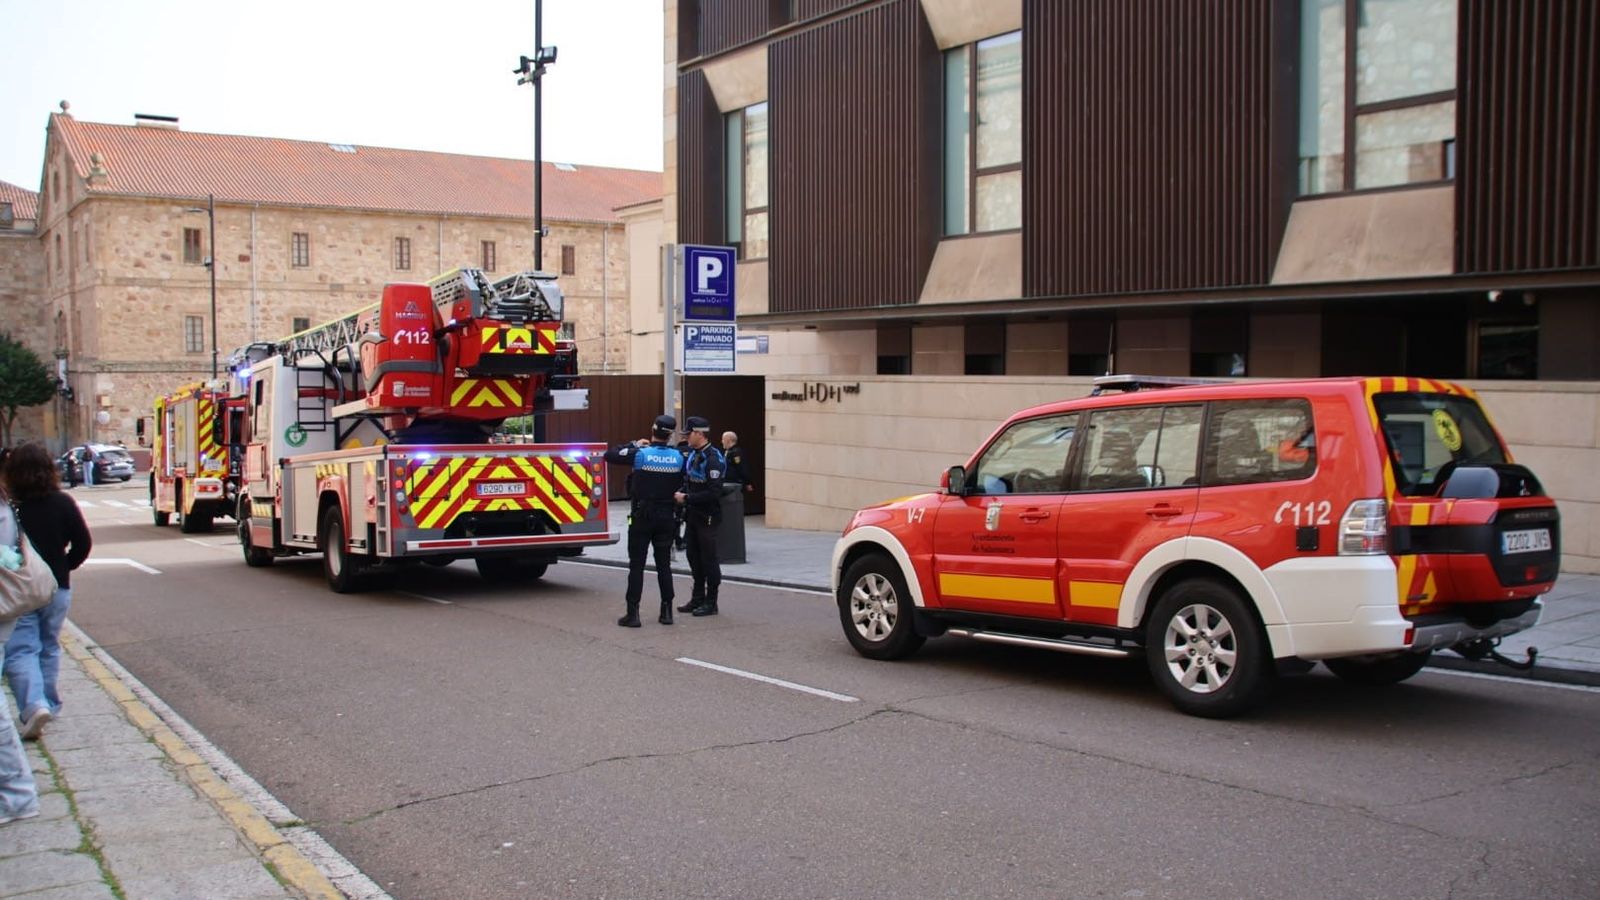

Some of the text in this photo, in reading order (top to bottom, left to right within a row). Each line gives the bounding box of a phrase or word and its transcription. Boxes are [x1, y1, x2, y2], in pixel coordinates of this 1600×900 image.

[698, 256, 722, 289] P
[687, 327, 698, 341] P
[701, 326, 732, 334] PARKING
[405, 331, 430, 345] 112
[701, 335, 732, 343] PRIVADO
[907, 507, 926, 523] V-7
[1291, 501, 1331, 526] 112
[1507, 534, 1530, 551] 2202
